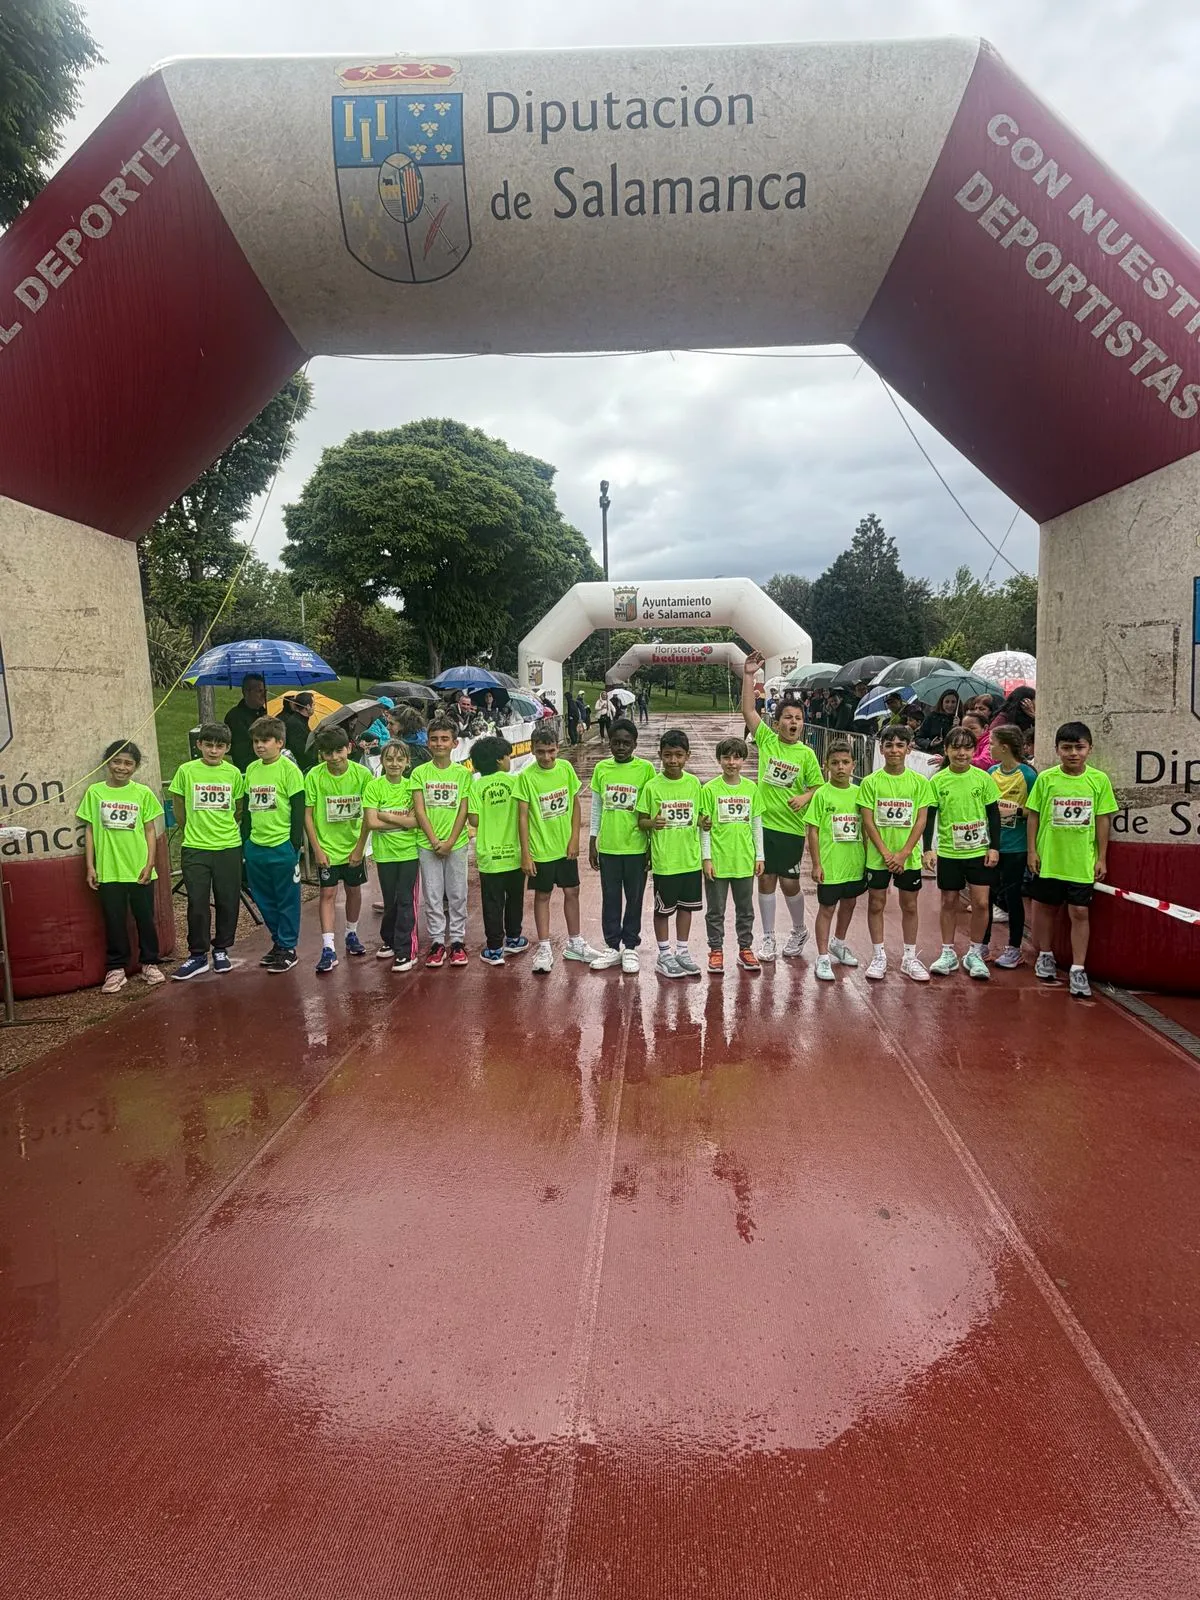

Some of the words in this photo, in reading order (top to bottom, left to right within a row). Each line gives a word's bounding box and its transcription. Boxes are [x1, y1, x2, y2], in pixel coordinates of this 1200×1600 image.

[487, 83, 754, 144] Diputación
[987, 114, 1072, 199] CON
[490, 180, 533, 221] de
[553, 163, 807, 219] Salamanca
[13, 128, 181, 313] DEPORTE
[955, 171, 1200, 420] DEPORTISTAS
[642, 596, 711, 609] Ayuntamiento
[643, 610, 654, 619] de
[658, 609, 711, 619] Salamanca
[772, 768, 788, 780] 56
[200, 792, 225, 802] 303
[255, 793, 268, 804] 78
[434, 790, 449, 800] 58
[612, 792, 627, 803] 60
[336, 804, 351, 814] 71
[550, 798, 565, 810] 62
[728, 804, 743, 815] 59
[110, 810, 127, 821] 68
[667, 810, 690, 820] 355
[886, 808, 903, 819] 66
[1063, 807, 1082, 818] 69
[1113, 808, 1148, 834] de
[1169, 801, 1200, 835] S
[843, 822, 857, 833] 63
[964, 830, 979, 841] 65
